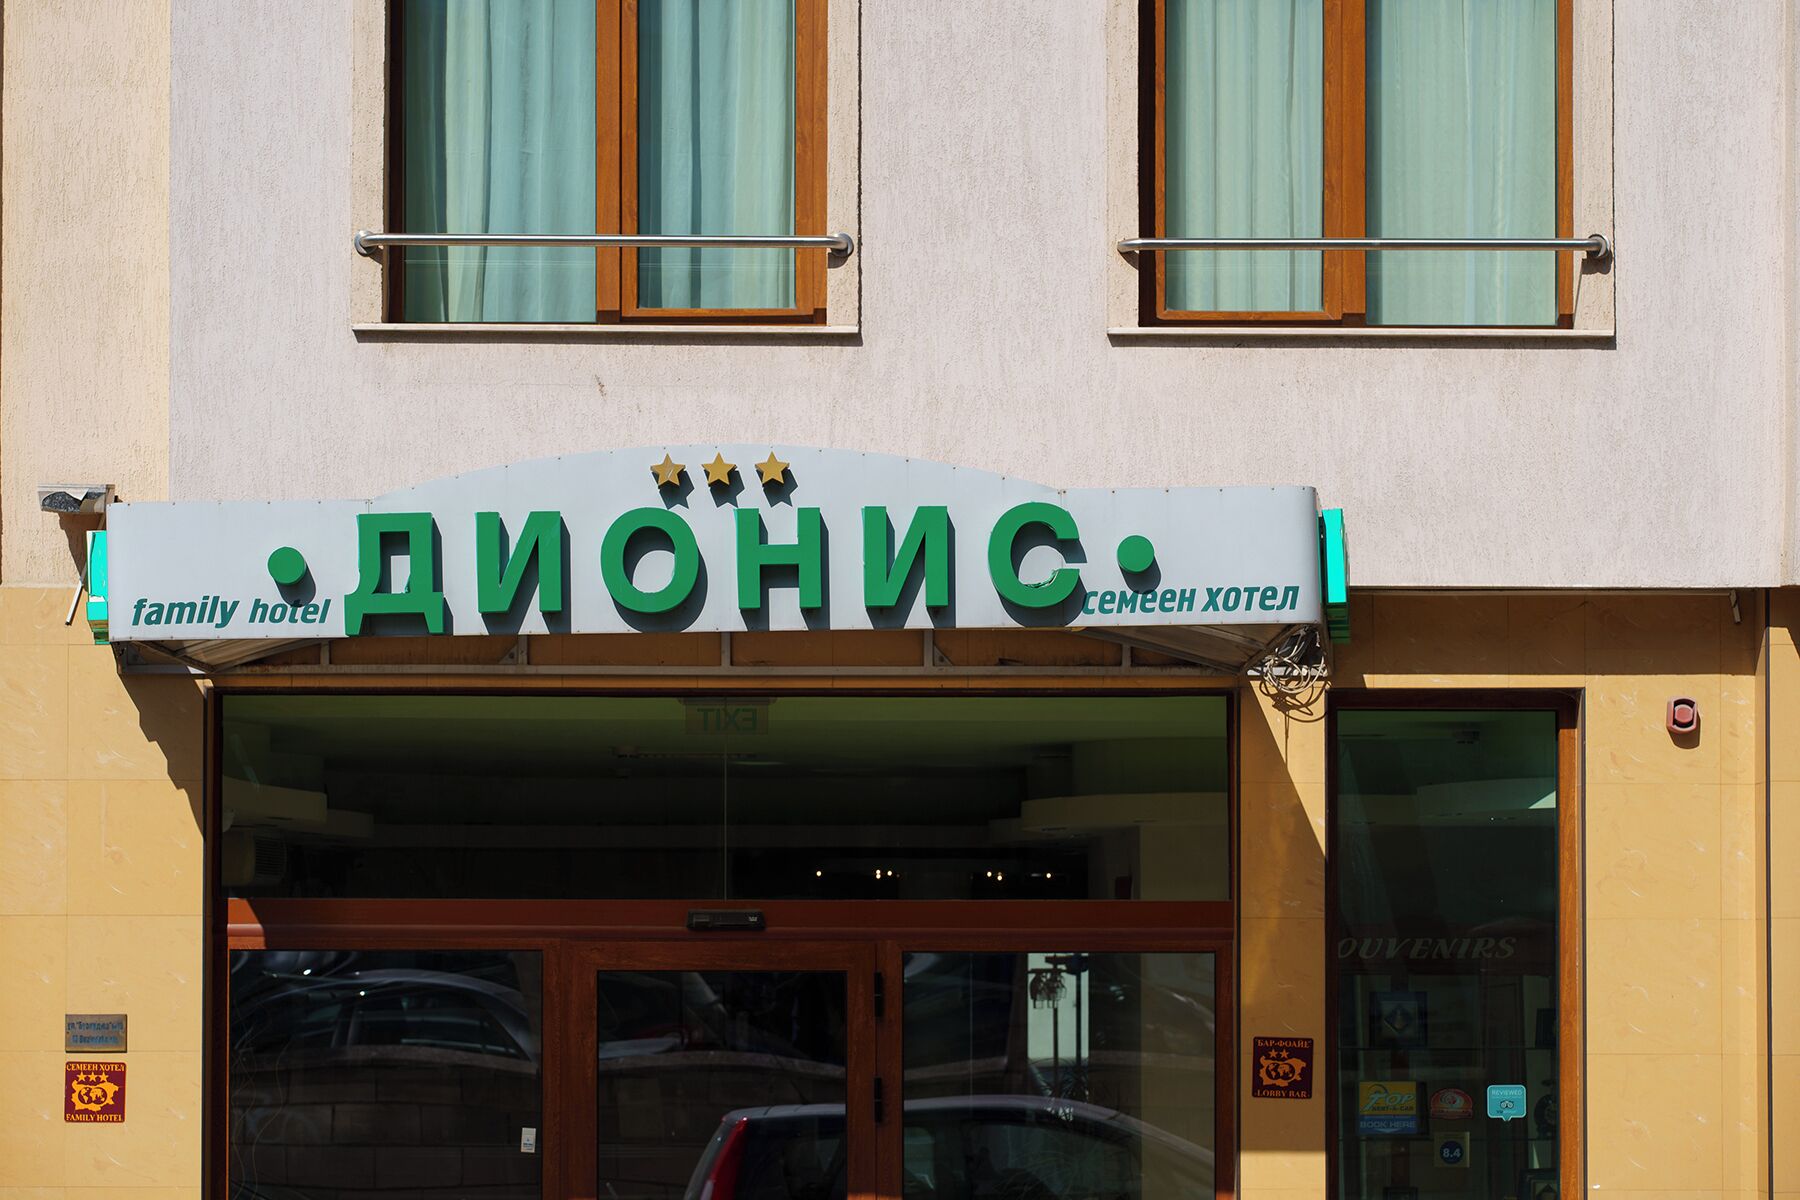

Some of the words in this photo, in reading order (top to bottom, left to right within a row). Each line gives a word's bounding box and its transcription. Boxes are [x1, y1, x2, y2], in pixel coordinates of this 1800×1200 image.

[344, 502, 1081, 635] ДИОНИС
[1081, 588, 1197, 615] семеен
[1201, 585, 1300, 612] хотел
[131, 595, 240, 628] family
[249, 599, 331, 624] hotel
[1337, 937, 1516, 960] OUVENIRS
[66, 1063, 98, 1071] СЕМЕЕН
[99, 1064, 124, 1072] ХОТЕЛ
[1289, 1090, 1307, 1098] BAR
[97, 1114, 123, 1122] HOTEL
[1360, 1120, 1387, 1128] BOOK
[1389, 1120, 1416, 1128] HERE
[1443, 1148, 1461, 1158] 8.4
